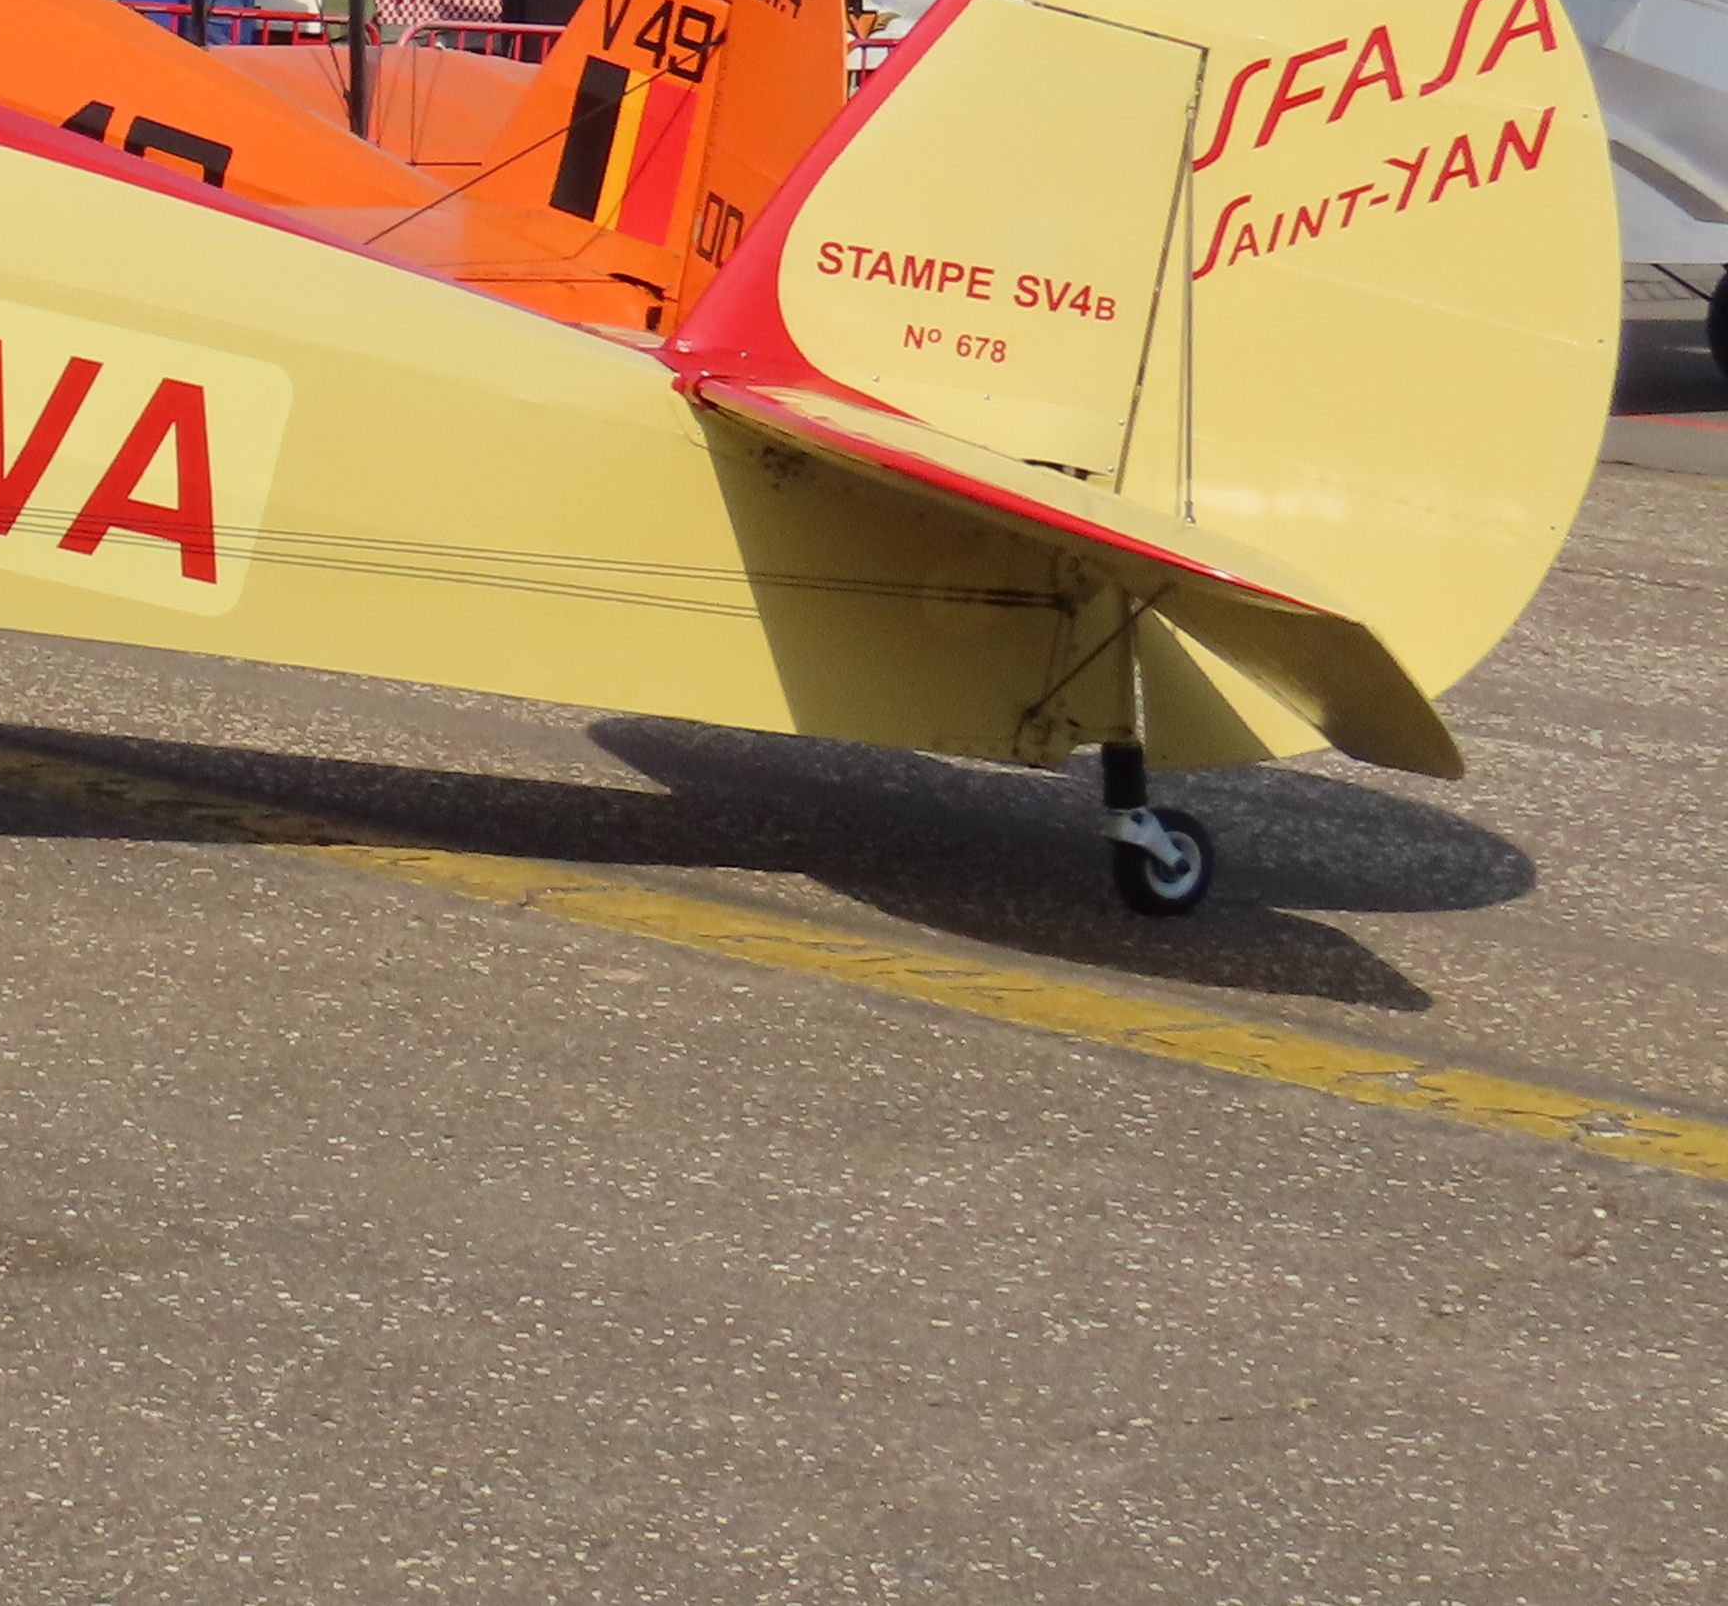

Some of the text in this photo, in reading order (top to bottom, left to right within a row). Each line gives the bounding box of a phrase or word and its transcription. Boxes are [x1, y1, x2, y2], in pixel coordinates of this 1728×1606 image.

[1193, 106, 1556, 281] SAINT-YAN
[816, 240, 1117, 322] STAMPE SV4B
[956, 333, 1008, 364] 678
